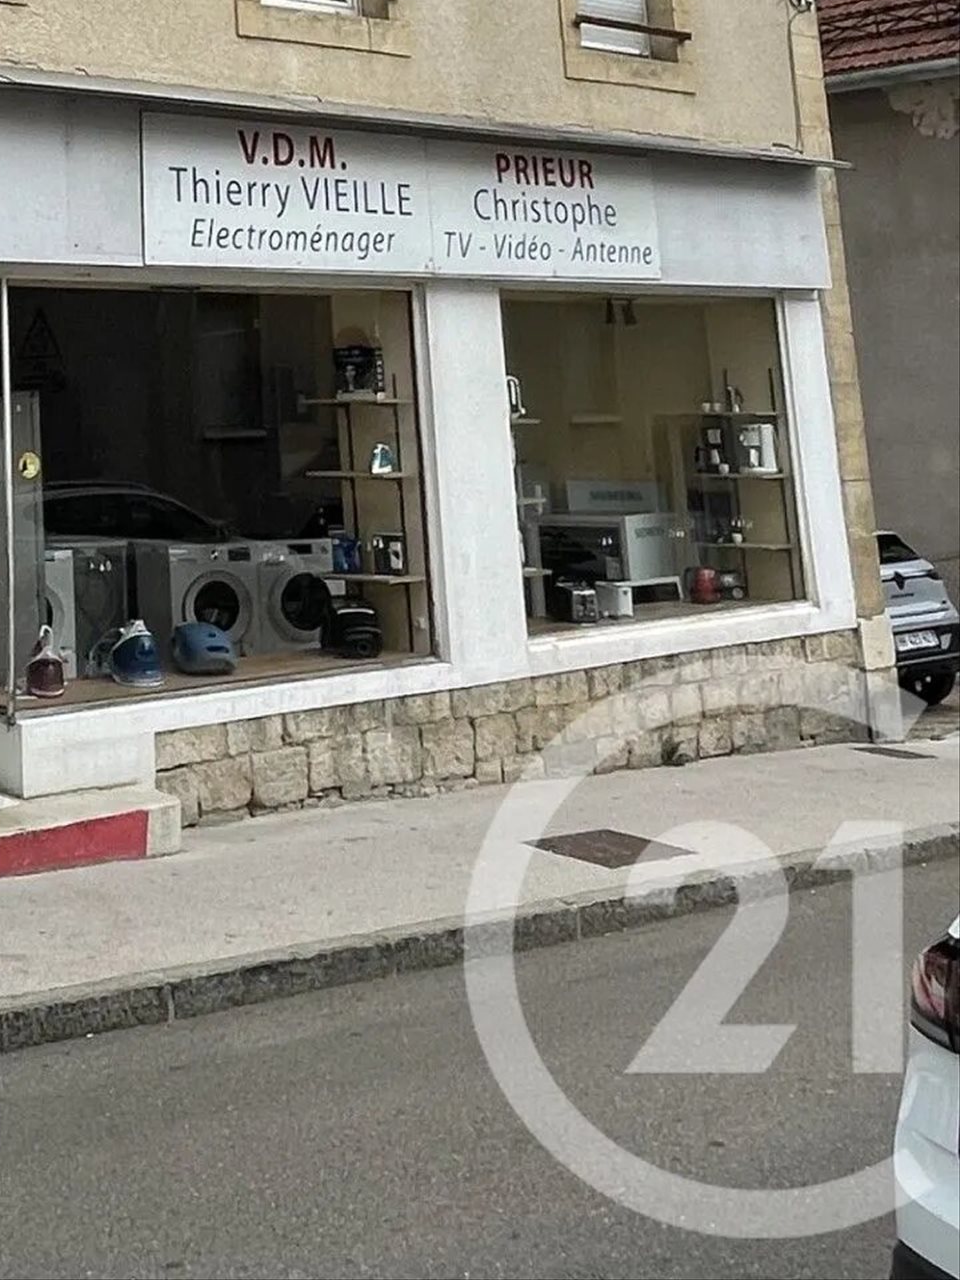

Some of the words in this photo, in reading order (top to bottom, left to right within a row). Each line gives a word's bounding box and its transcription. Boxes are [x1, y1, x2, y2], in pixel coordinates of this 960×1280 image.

[238, 129, 347, 170] V.D.M.
[168, 166, 290, 218] Thierry
[300, 175, 413, 217] VIEILLE
[495, 152, 595, 190] PRIEUR
[473, 188, 617, 232] Christophe
[190, 218, 396, 261] Electroménager
[443, 231, 473, 258] TV
[493, 233, 551, 261] Vidéo
[570, 237, 653, 265] Antenne
